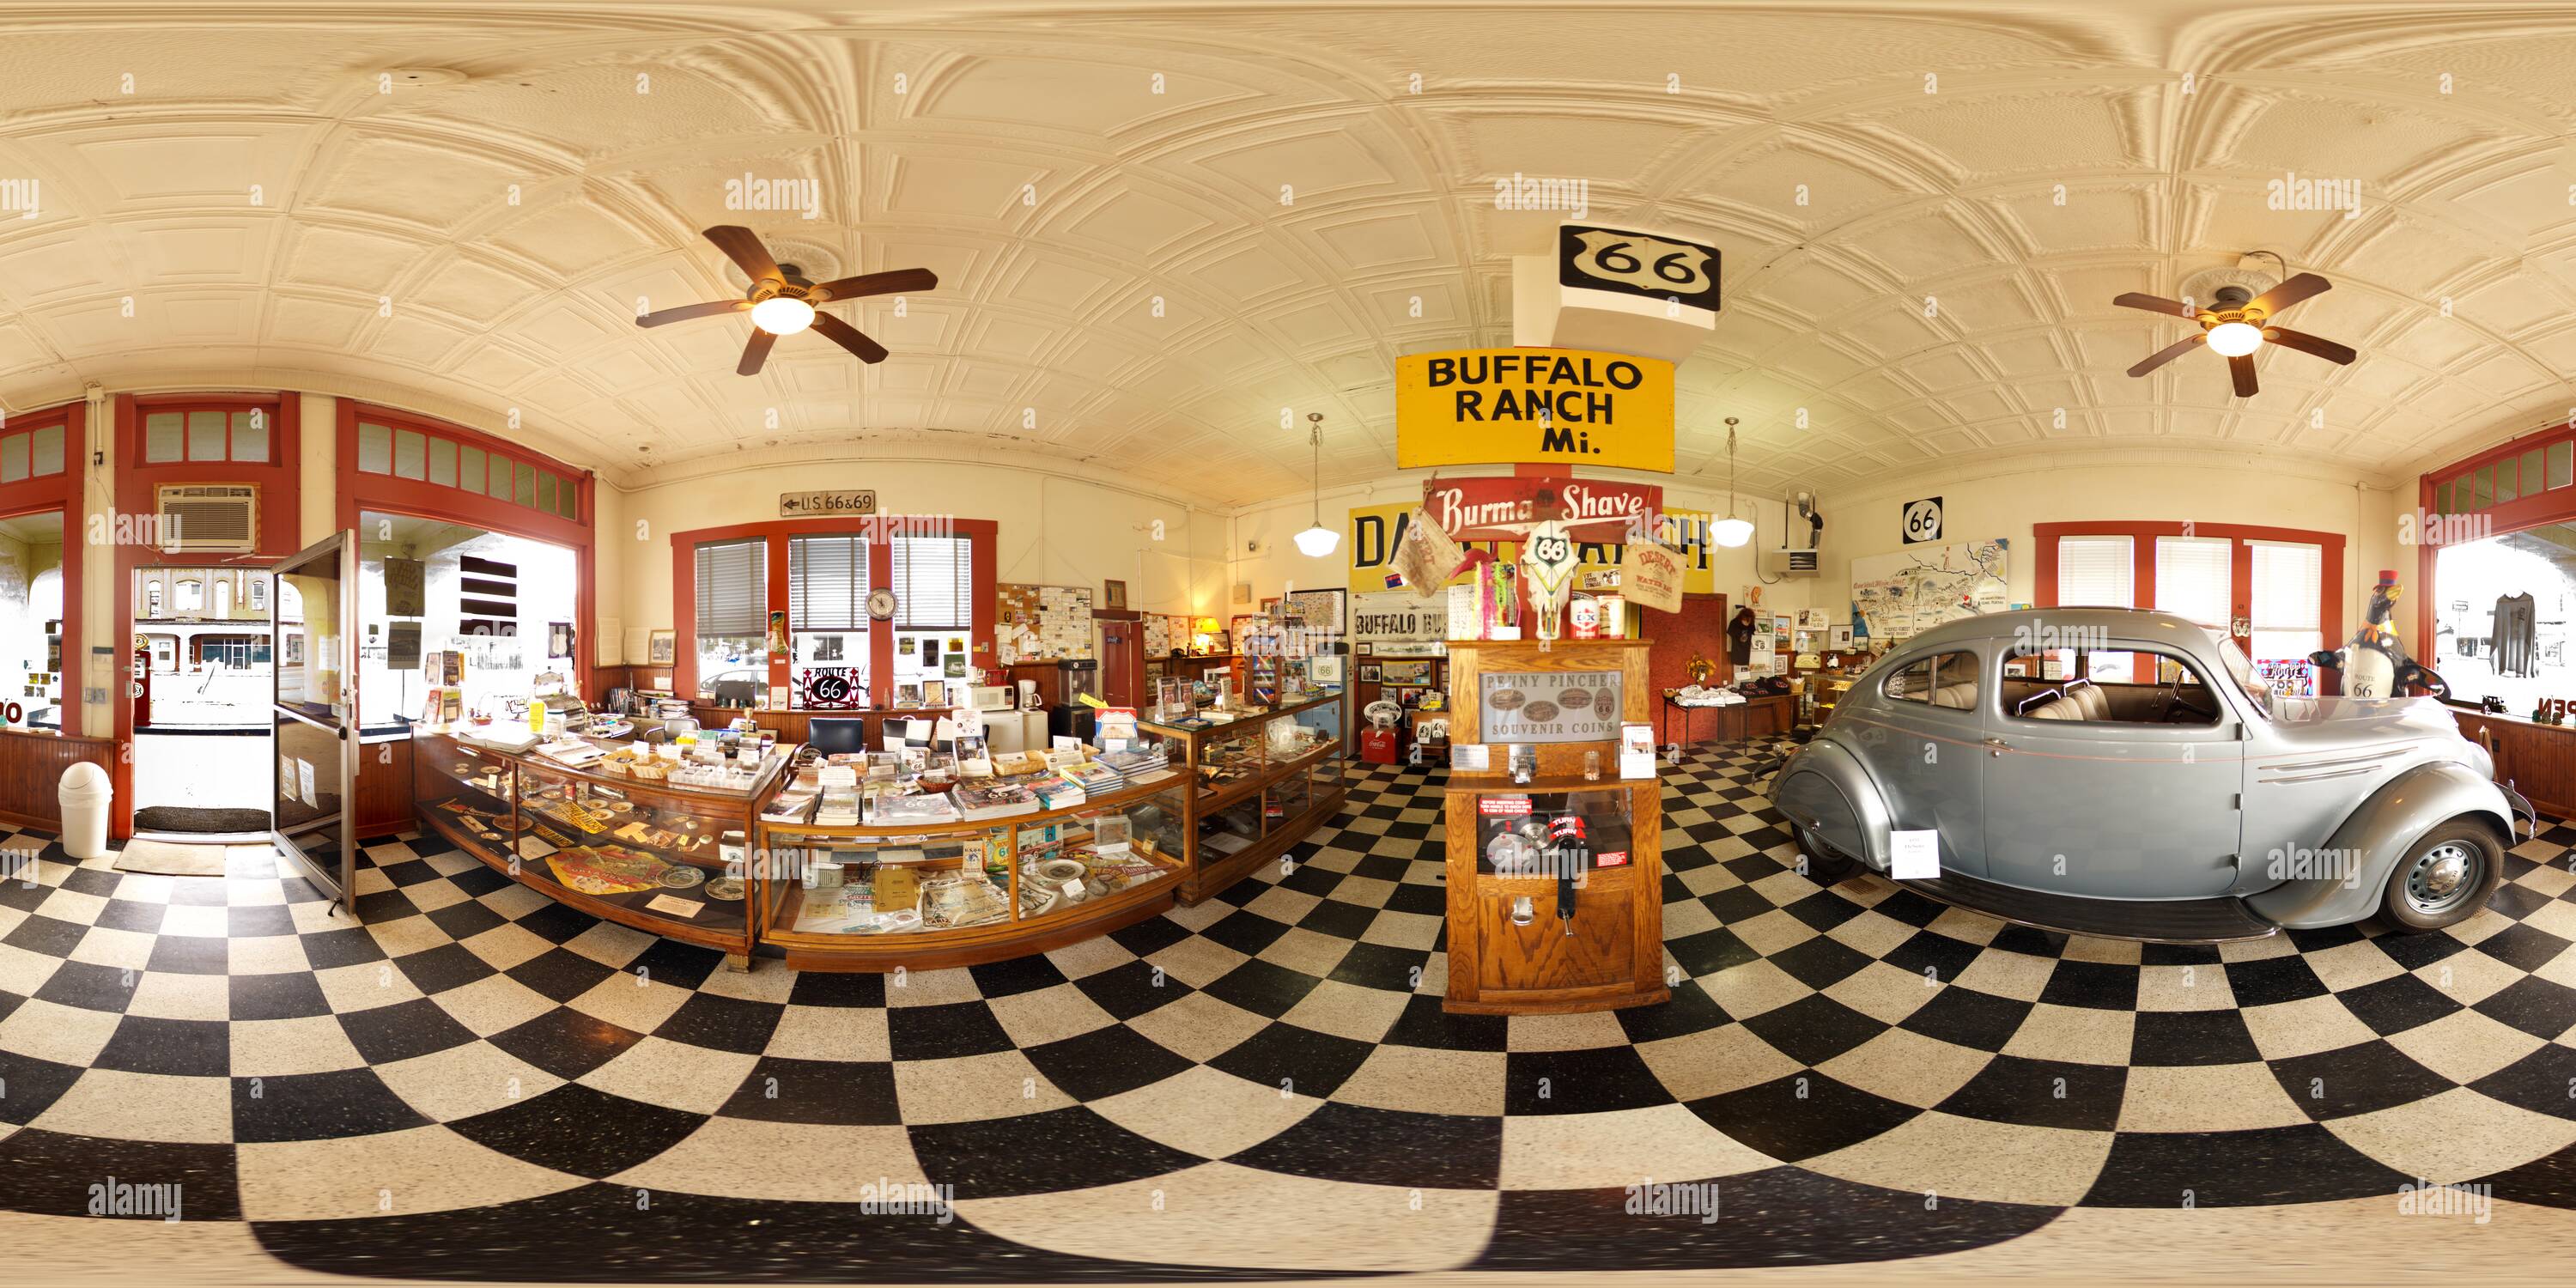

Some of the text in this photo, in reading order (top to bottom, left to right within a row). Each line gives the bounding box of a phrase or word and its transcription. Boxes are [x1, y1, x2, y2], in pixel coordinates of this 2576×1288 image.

[1595, 242, 1697, 284] 66
[1427, 355, 1643, 391] BUFFALO
[1455, 389, 1613, 425] RANCH
[1540, 428, 1601, 454] Mi.
[801, 495, 823, 510] U.S.
[1436, 484, 1644, 535] Burma Shave
[1909, 507, 1935, 532] 66
[1537, 538, 1565, 561] 66
[1638, 550, 1677, 575] DESERT
[1636, 574, 1663, 588] WATER
[1355, 612, 1416, 634] BUFFALO
[815, 667, 848, 677] ROUTE
[1321, 666, 1331, 675] 66
[2354, 673, 2375, 682] ROUTE
[819, 678, 841, 699] 66
[1486, 674, 1618, 689] PENNY PINCHER
[2353, 682, 2372, 698] 66
[1492, 722, 1613, 735] SOUVENIR COINS
[988, 791, 1009, 799] 66
[1552, 817, 1577, 825] TURN
[1553, 828, 1577, 836] TURN
